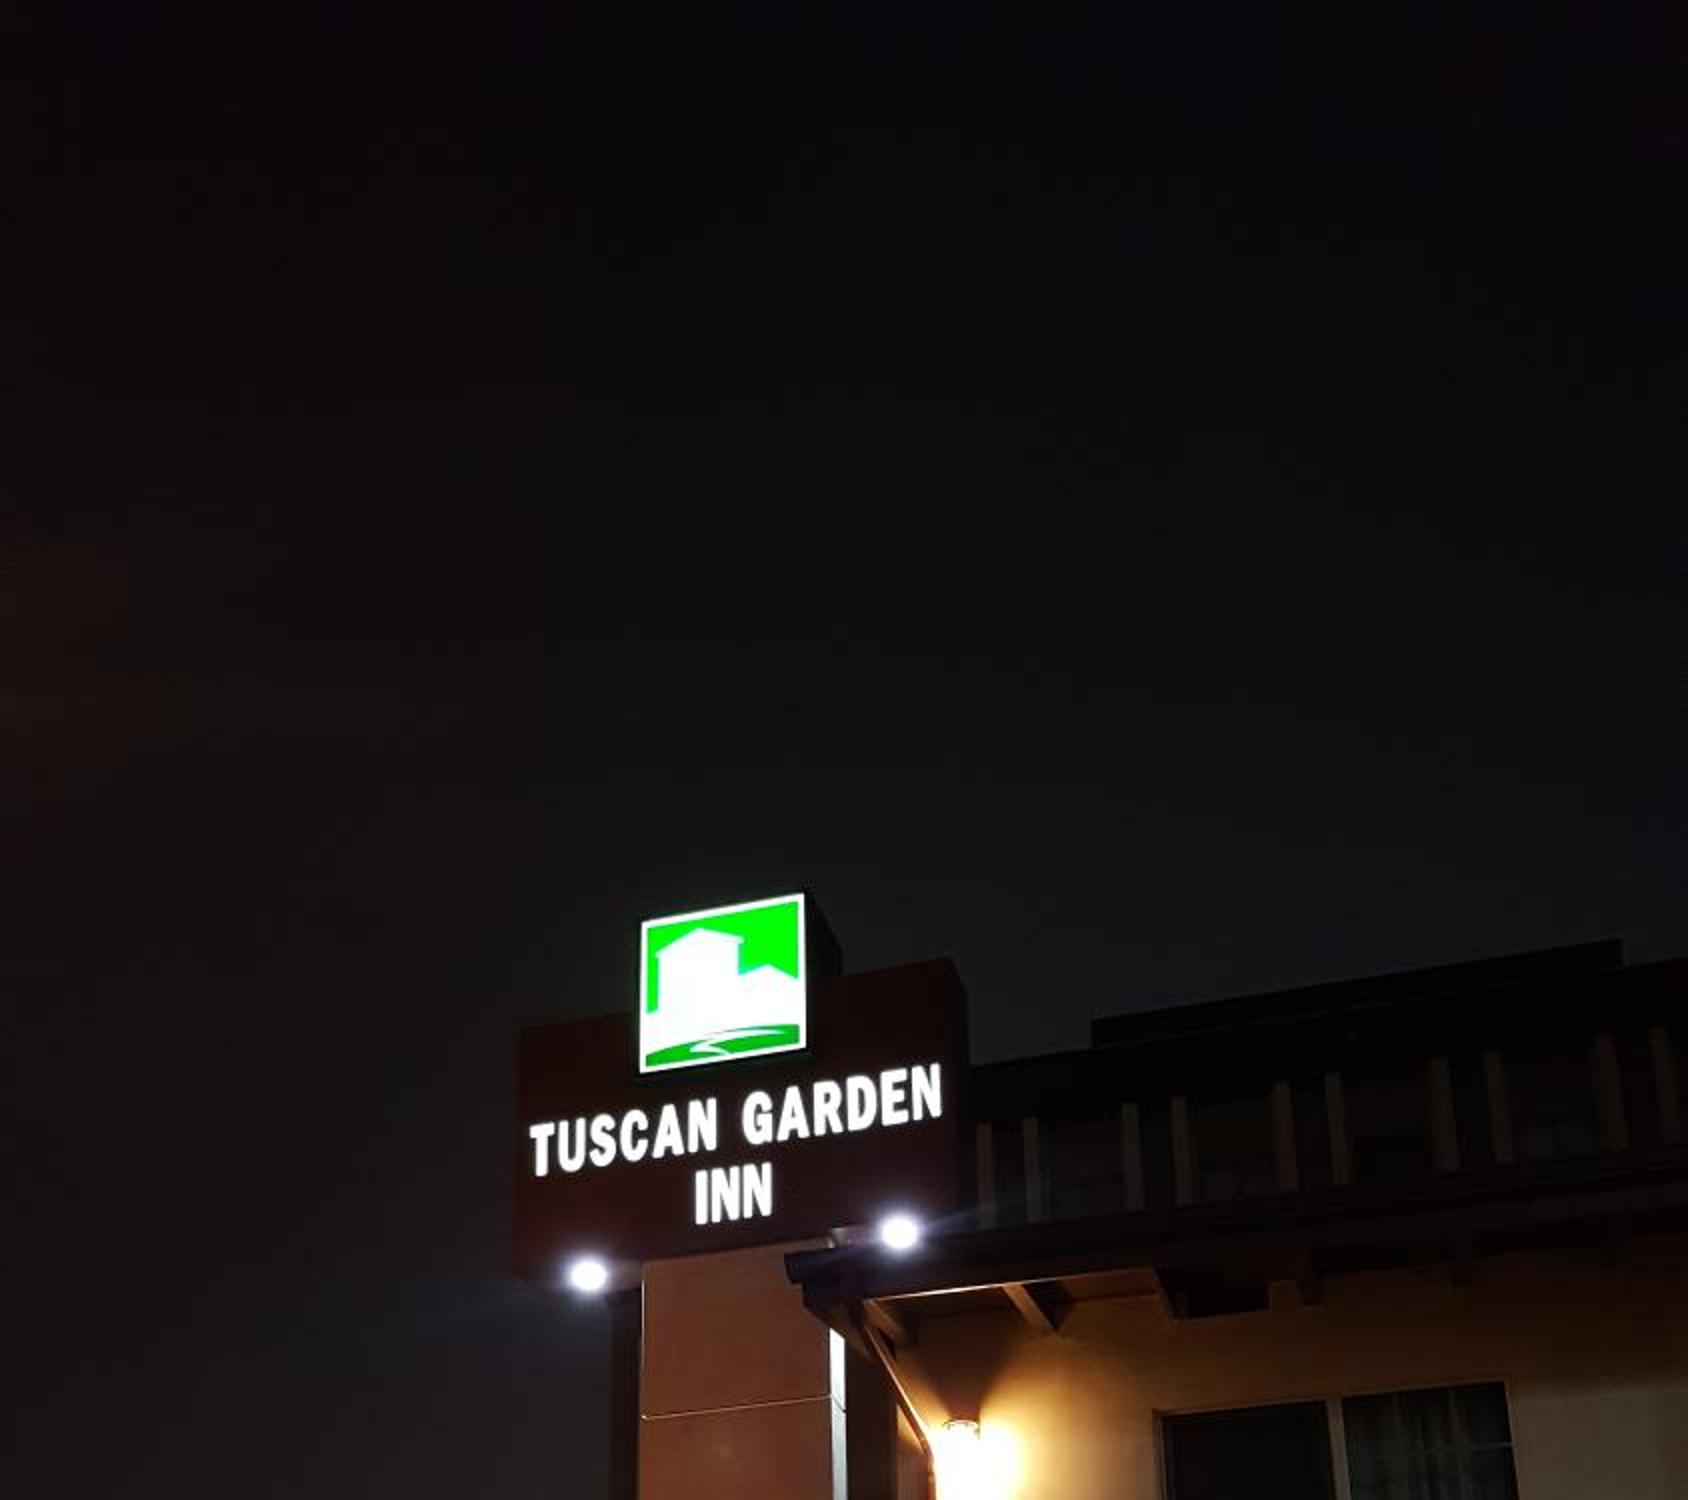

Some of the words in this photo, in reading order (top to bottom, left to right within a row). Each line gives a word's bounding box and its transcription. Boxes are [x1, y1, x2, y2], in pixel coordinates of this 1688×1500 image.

[529, 1097, 717, 1177] TUSCAN
[741, 1063, 942, 1146] GARDEN
[694, 1162, 772, 1225] INN
